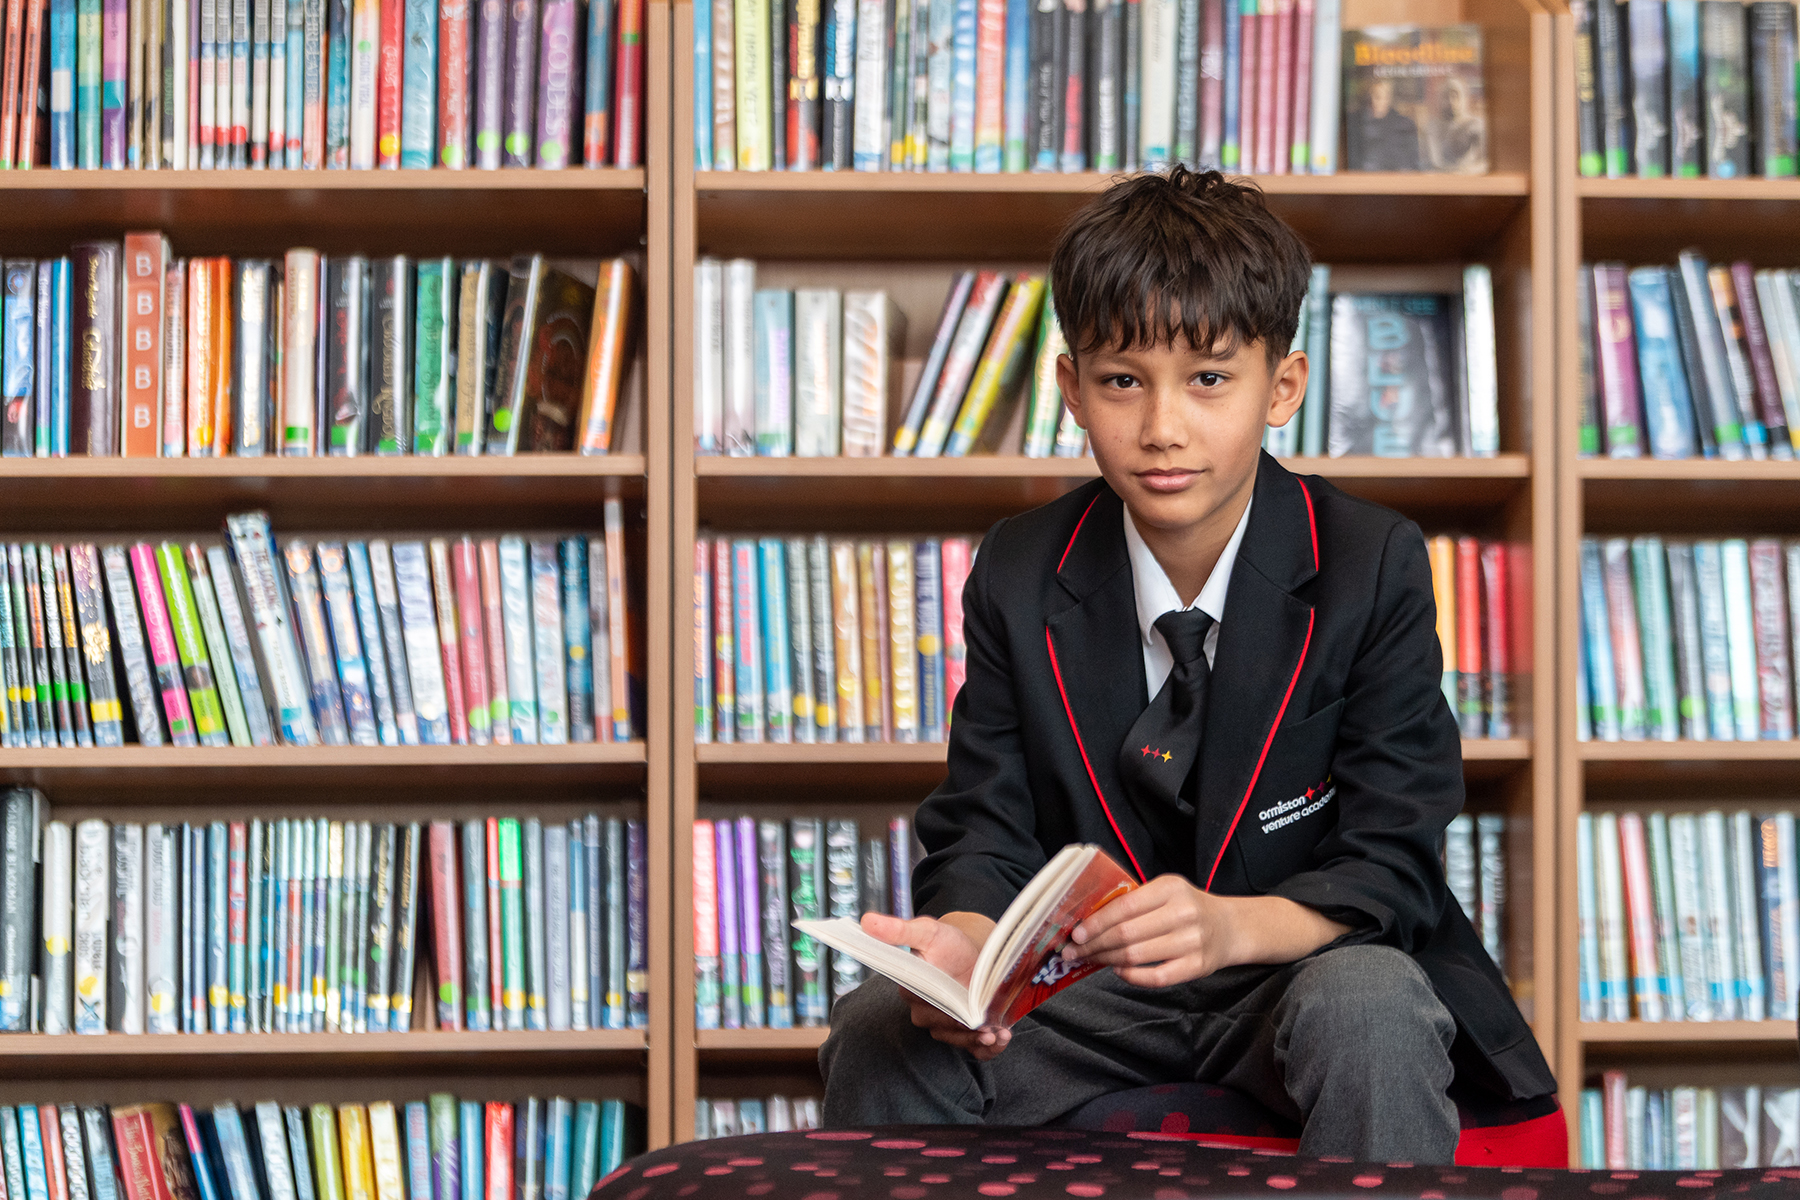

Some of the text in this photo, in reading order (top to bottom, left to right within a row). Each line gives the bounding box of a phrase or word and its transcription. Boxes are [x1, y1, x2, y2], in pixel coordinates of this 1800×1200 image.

[1354, 42, 1473, 66] Bloodline
[545, 31, 571, 136] GODDESS
[135, 250, 153, 277] B
[136, 289, 154, 316] B
[135, 327, 153, 352] B
[134, 366, 152, 390] B
[133, 405, 151, 429] B
[1258, 795, 1306, 821] ormiston
[1261, 785, 1337, 835] venture academ
[6, 852, 17, 914] BLACKMAN
